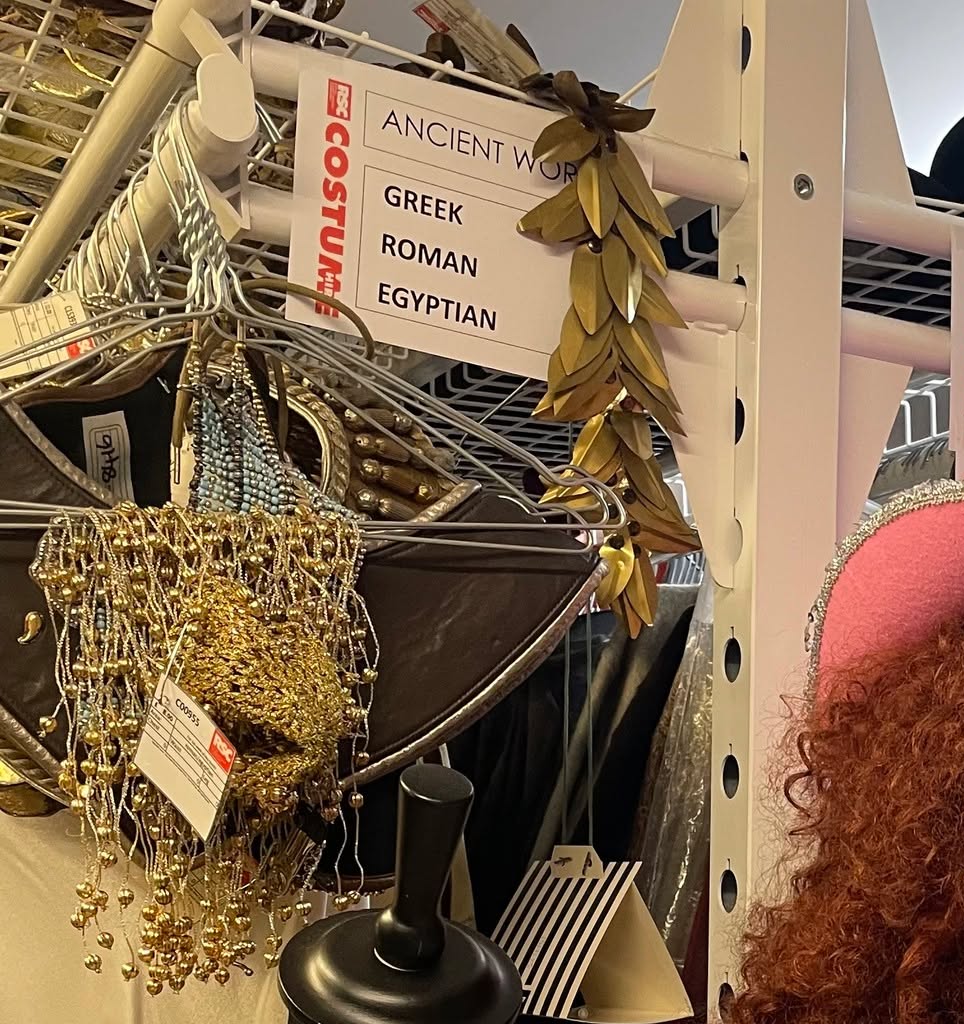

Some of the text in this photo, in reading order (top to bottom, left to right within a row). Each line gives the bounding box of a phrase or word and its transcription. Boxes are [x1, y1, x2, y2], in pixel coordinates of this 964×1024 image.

[381, 109, 578, 185] ANCIENT WOR
[384, 184, 464, 226] GREEK
[381, 233, 478, 279] ROMAN
[378, 282, 497, 332] EGYPTIAN
[175, 698, 201, 727] C00955
